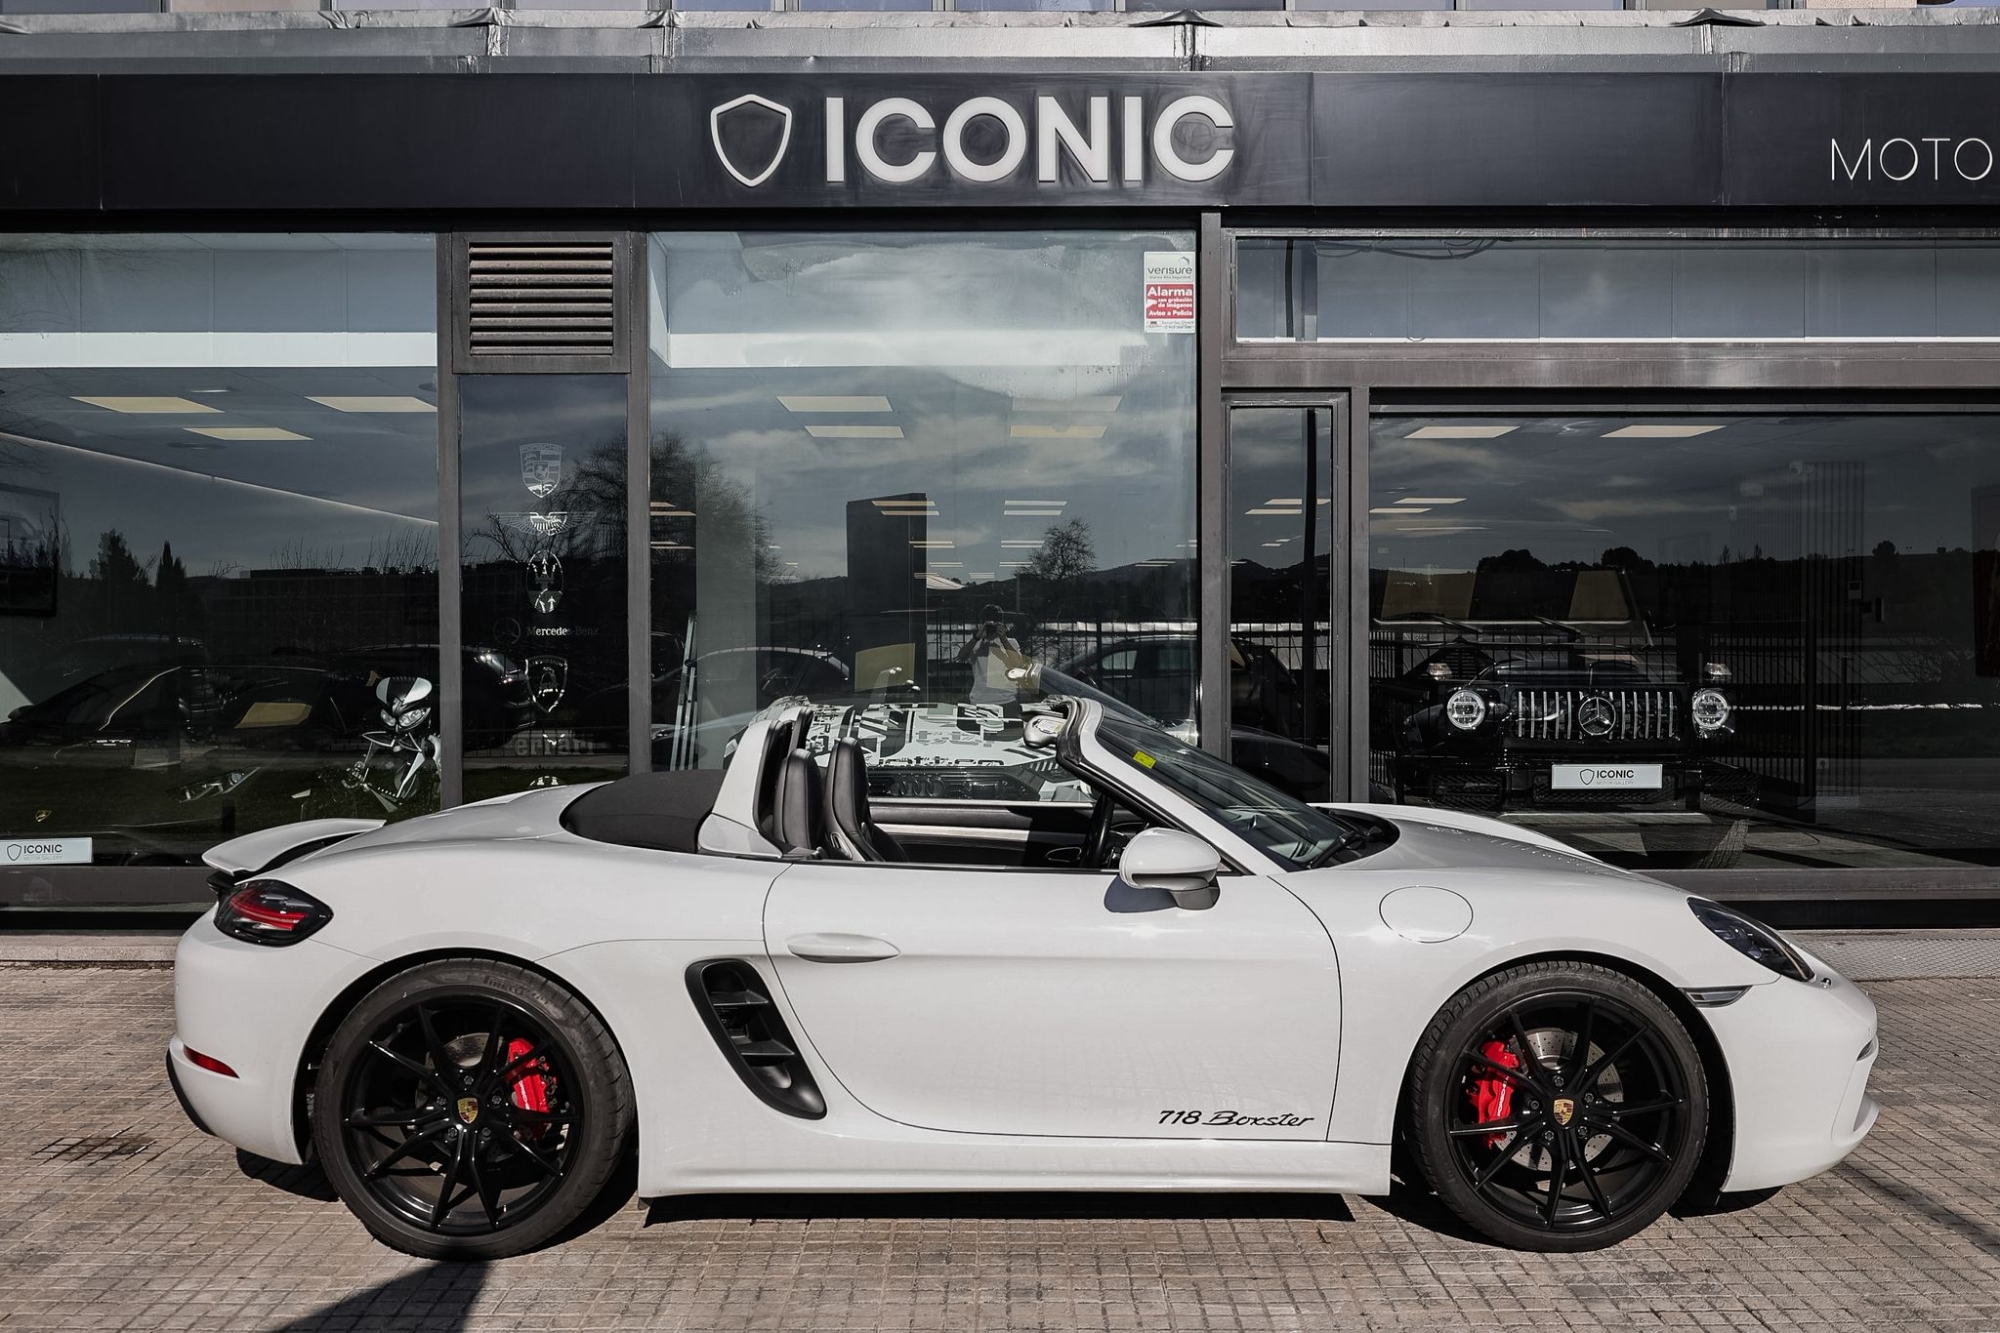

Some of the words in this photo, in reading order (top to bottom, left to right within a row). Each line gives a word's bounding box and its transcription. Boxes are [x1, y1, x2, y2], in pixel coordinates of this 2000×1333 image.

[826, 95, 1234, 183] ICONIC
[1831, 137, 1993, 181] MOTO
[1147, 267, 1193, 275] verisure
[1147, 286, 1193, 297] Alarma
[527, 626, 599, 636] Mercedes-Benz
[1597, 770, 1634, 779] ICONIC
[23, 844, 63, 854] ICONIC
[1158, 1110, 1202, 1125] 718
[1201, 1110, 1315, 1127] Boxster
